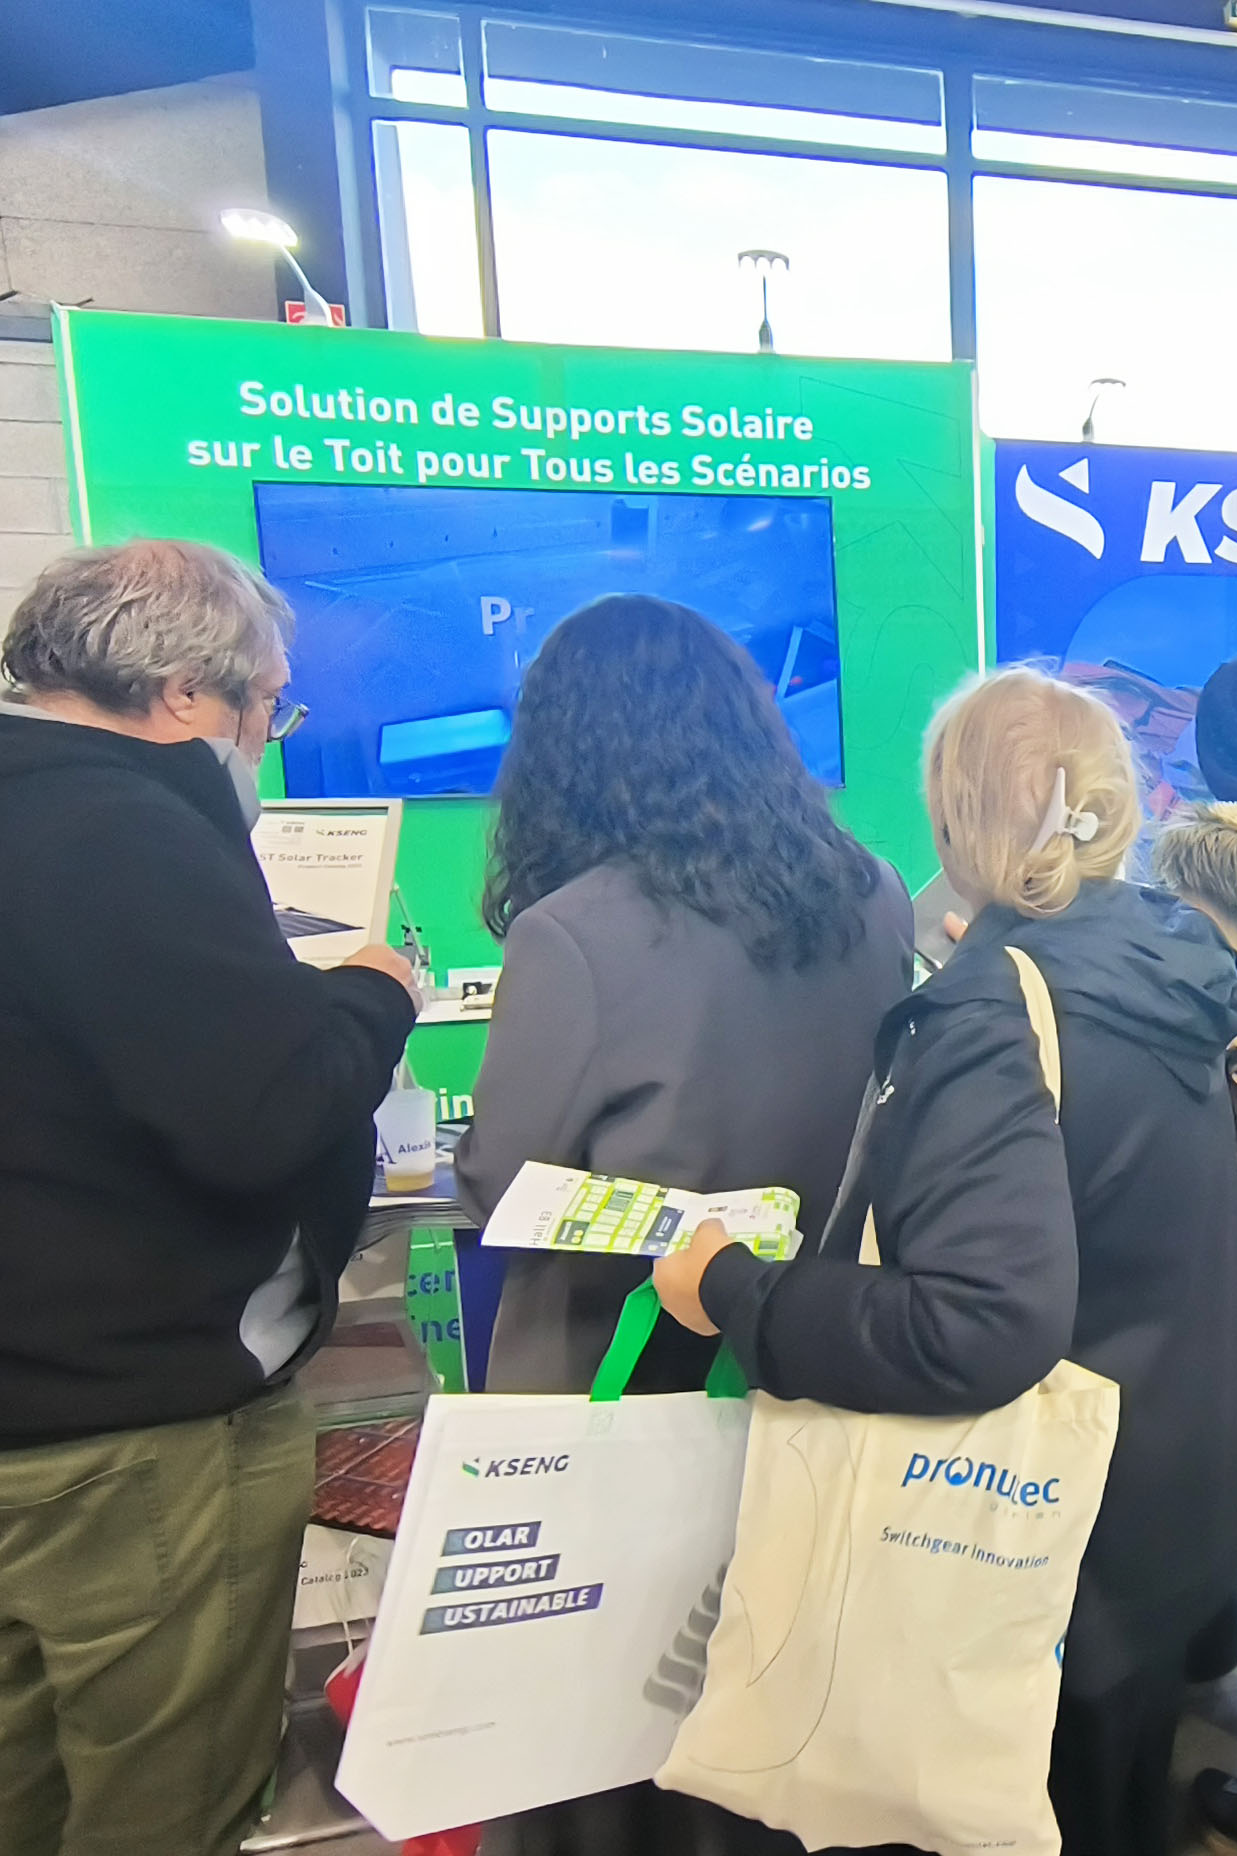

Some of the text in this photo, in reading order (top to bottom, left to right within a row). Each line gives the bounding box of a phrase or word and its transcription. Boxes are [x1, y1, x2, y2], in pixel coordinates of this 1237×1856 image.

[239, 380, 814, 441] Solution de Supports Solaire
[187, 435, 871, 490] sur le Toit pour Tous les Scénarios
[326, 829, 368, 837] KSENG
[280, 853, 313, 862] Solar
[316, 853, 364, 862] Tracker
[436, 1088, 475, 1121] in
[485, 1454, 570, 1479] KSENG
[463, 1526, 531, 1550] OLAR
[880, 1525, 969, 1556] Switchgear
[454, 1558, 554, 1589] UPPORT
[444, 1588, 591, 1627] USTAINABLE
